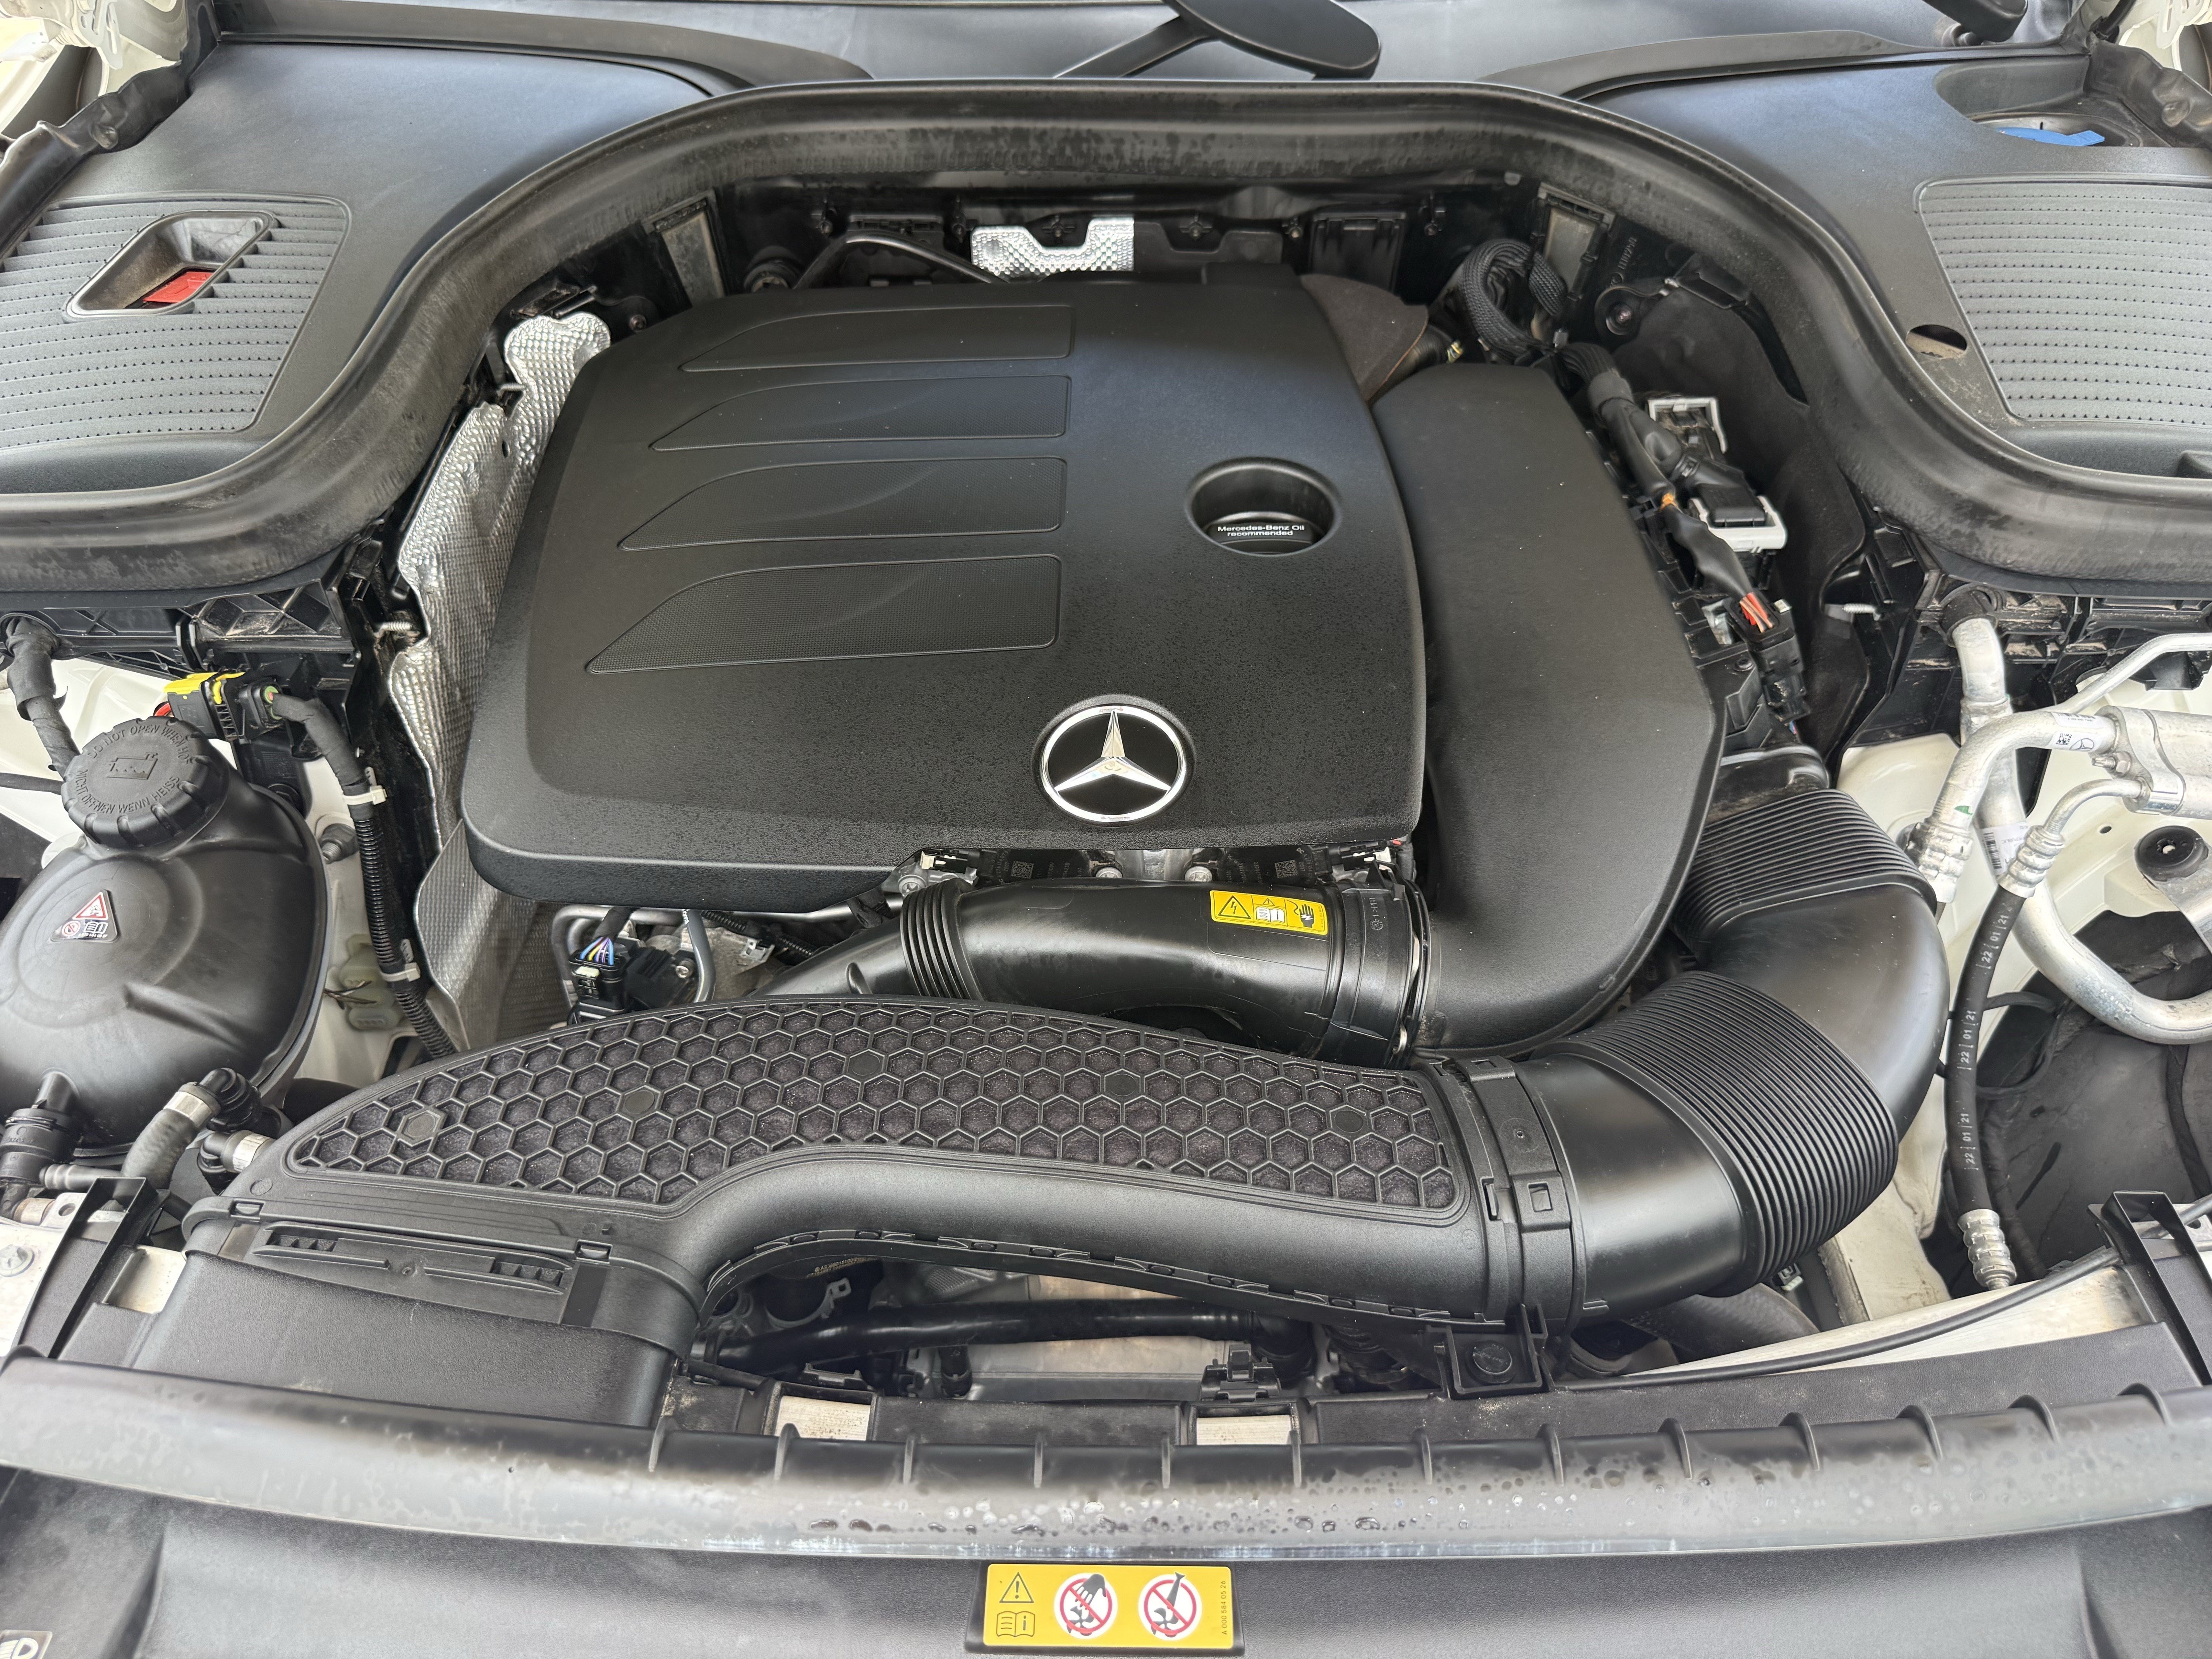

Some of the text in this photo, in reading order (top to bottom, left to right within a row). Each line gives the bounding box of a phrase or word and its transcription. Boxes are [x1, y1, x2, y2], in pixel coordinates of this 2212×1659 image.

[88, 725, 193, 764] DO NOT OPEN WHEN HOT
[75, 769, 89, 795] NICHT
[118, 797, 151, 814] WENN
[151, 776, 180, 801] HEISS
[1981, 915, 2009, 963] 22 01 21
[1960, 1010, 1977, 1064] 22 01 21
[1960, 1113, 1975, 1164] 22 01 21
[1220, 1580, 1226, 1589] 26
[1220, 1590, 1226, 1599] 05
